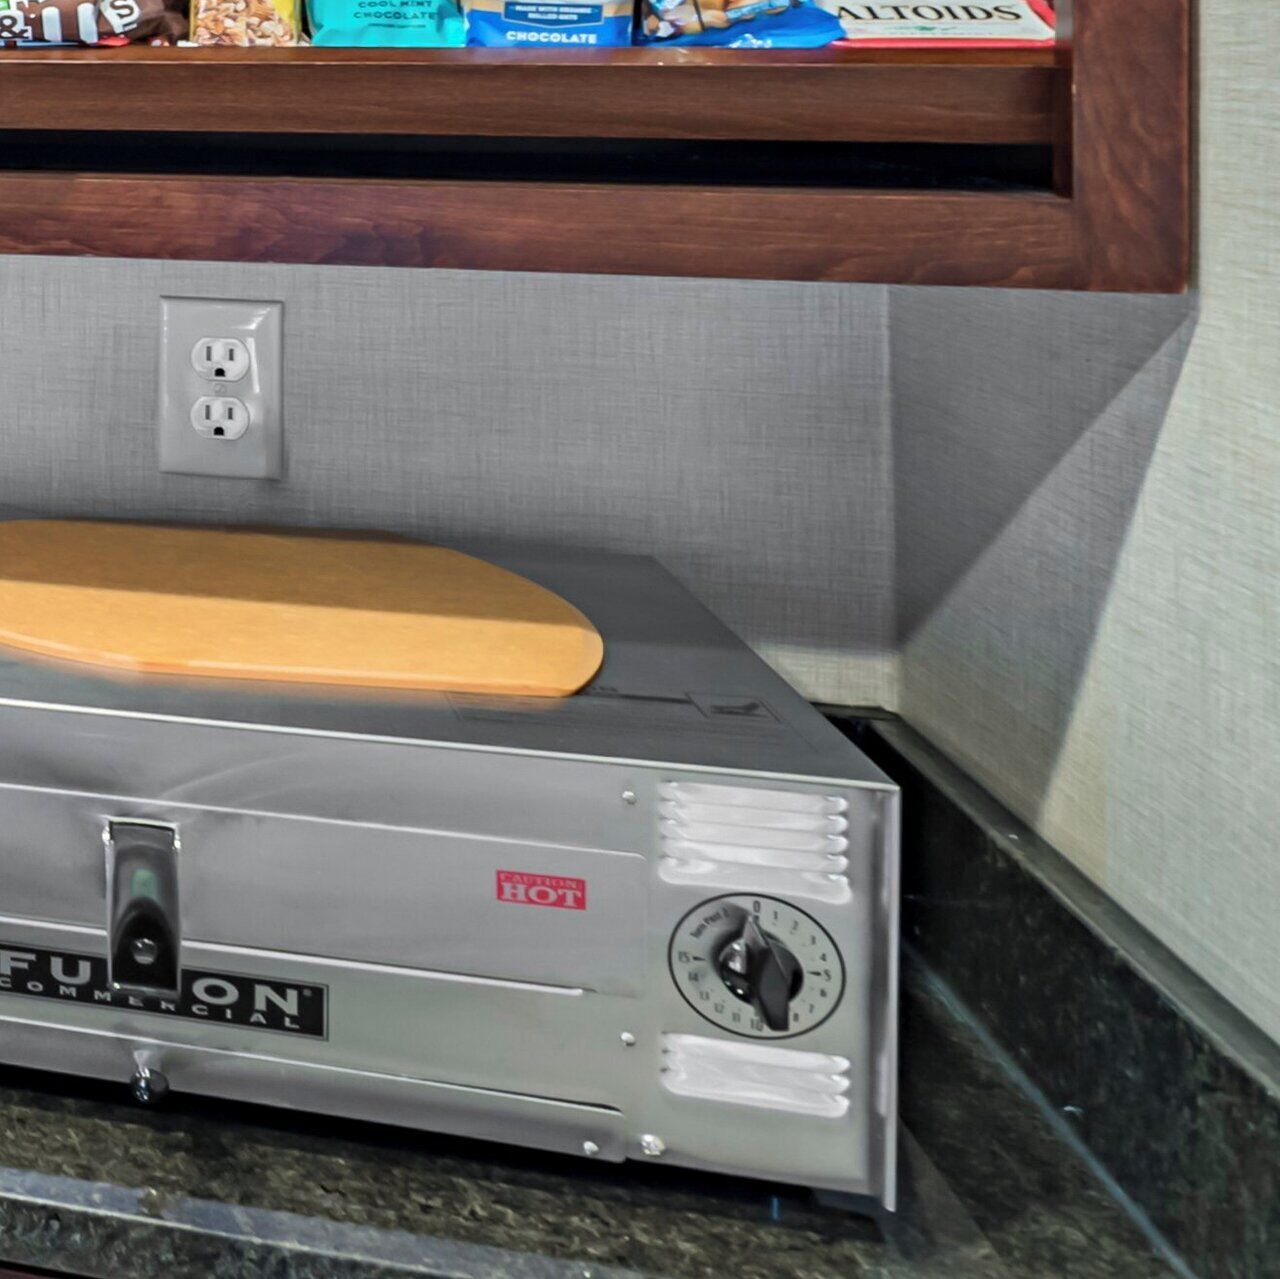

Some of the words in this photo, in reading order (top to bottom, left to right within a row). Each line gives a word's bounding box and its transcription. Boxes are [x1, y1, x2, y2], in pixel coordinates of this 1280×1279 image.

[358, 0, 397, 9] COOL
[400, 0, 433, 8] MINT
[353, 11, 439, 20] CHOCOLATE
[837, 5, 1023, 22] ALTOIDS
[506, 30, 598, 44] CHOCOLATE
[500, 872, 577, 888] CAUTION
[501, 882, 582, 908] HOT
[752, 900, 761, 913] 0
